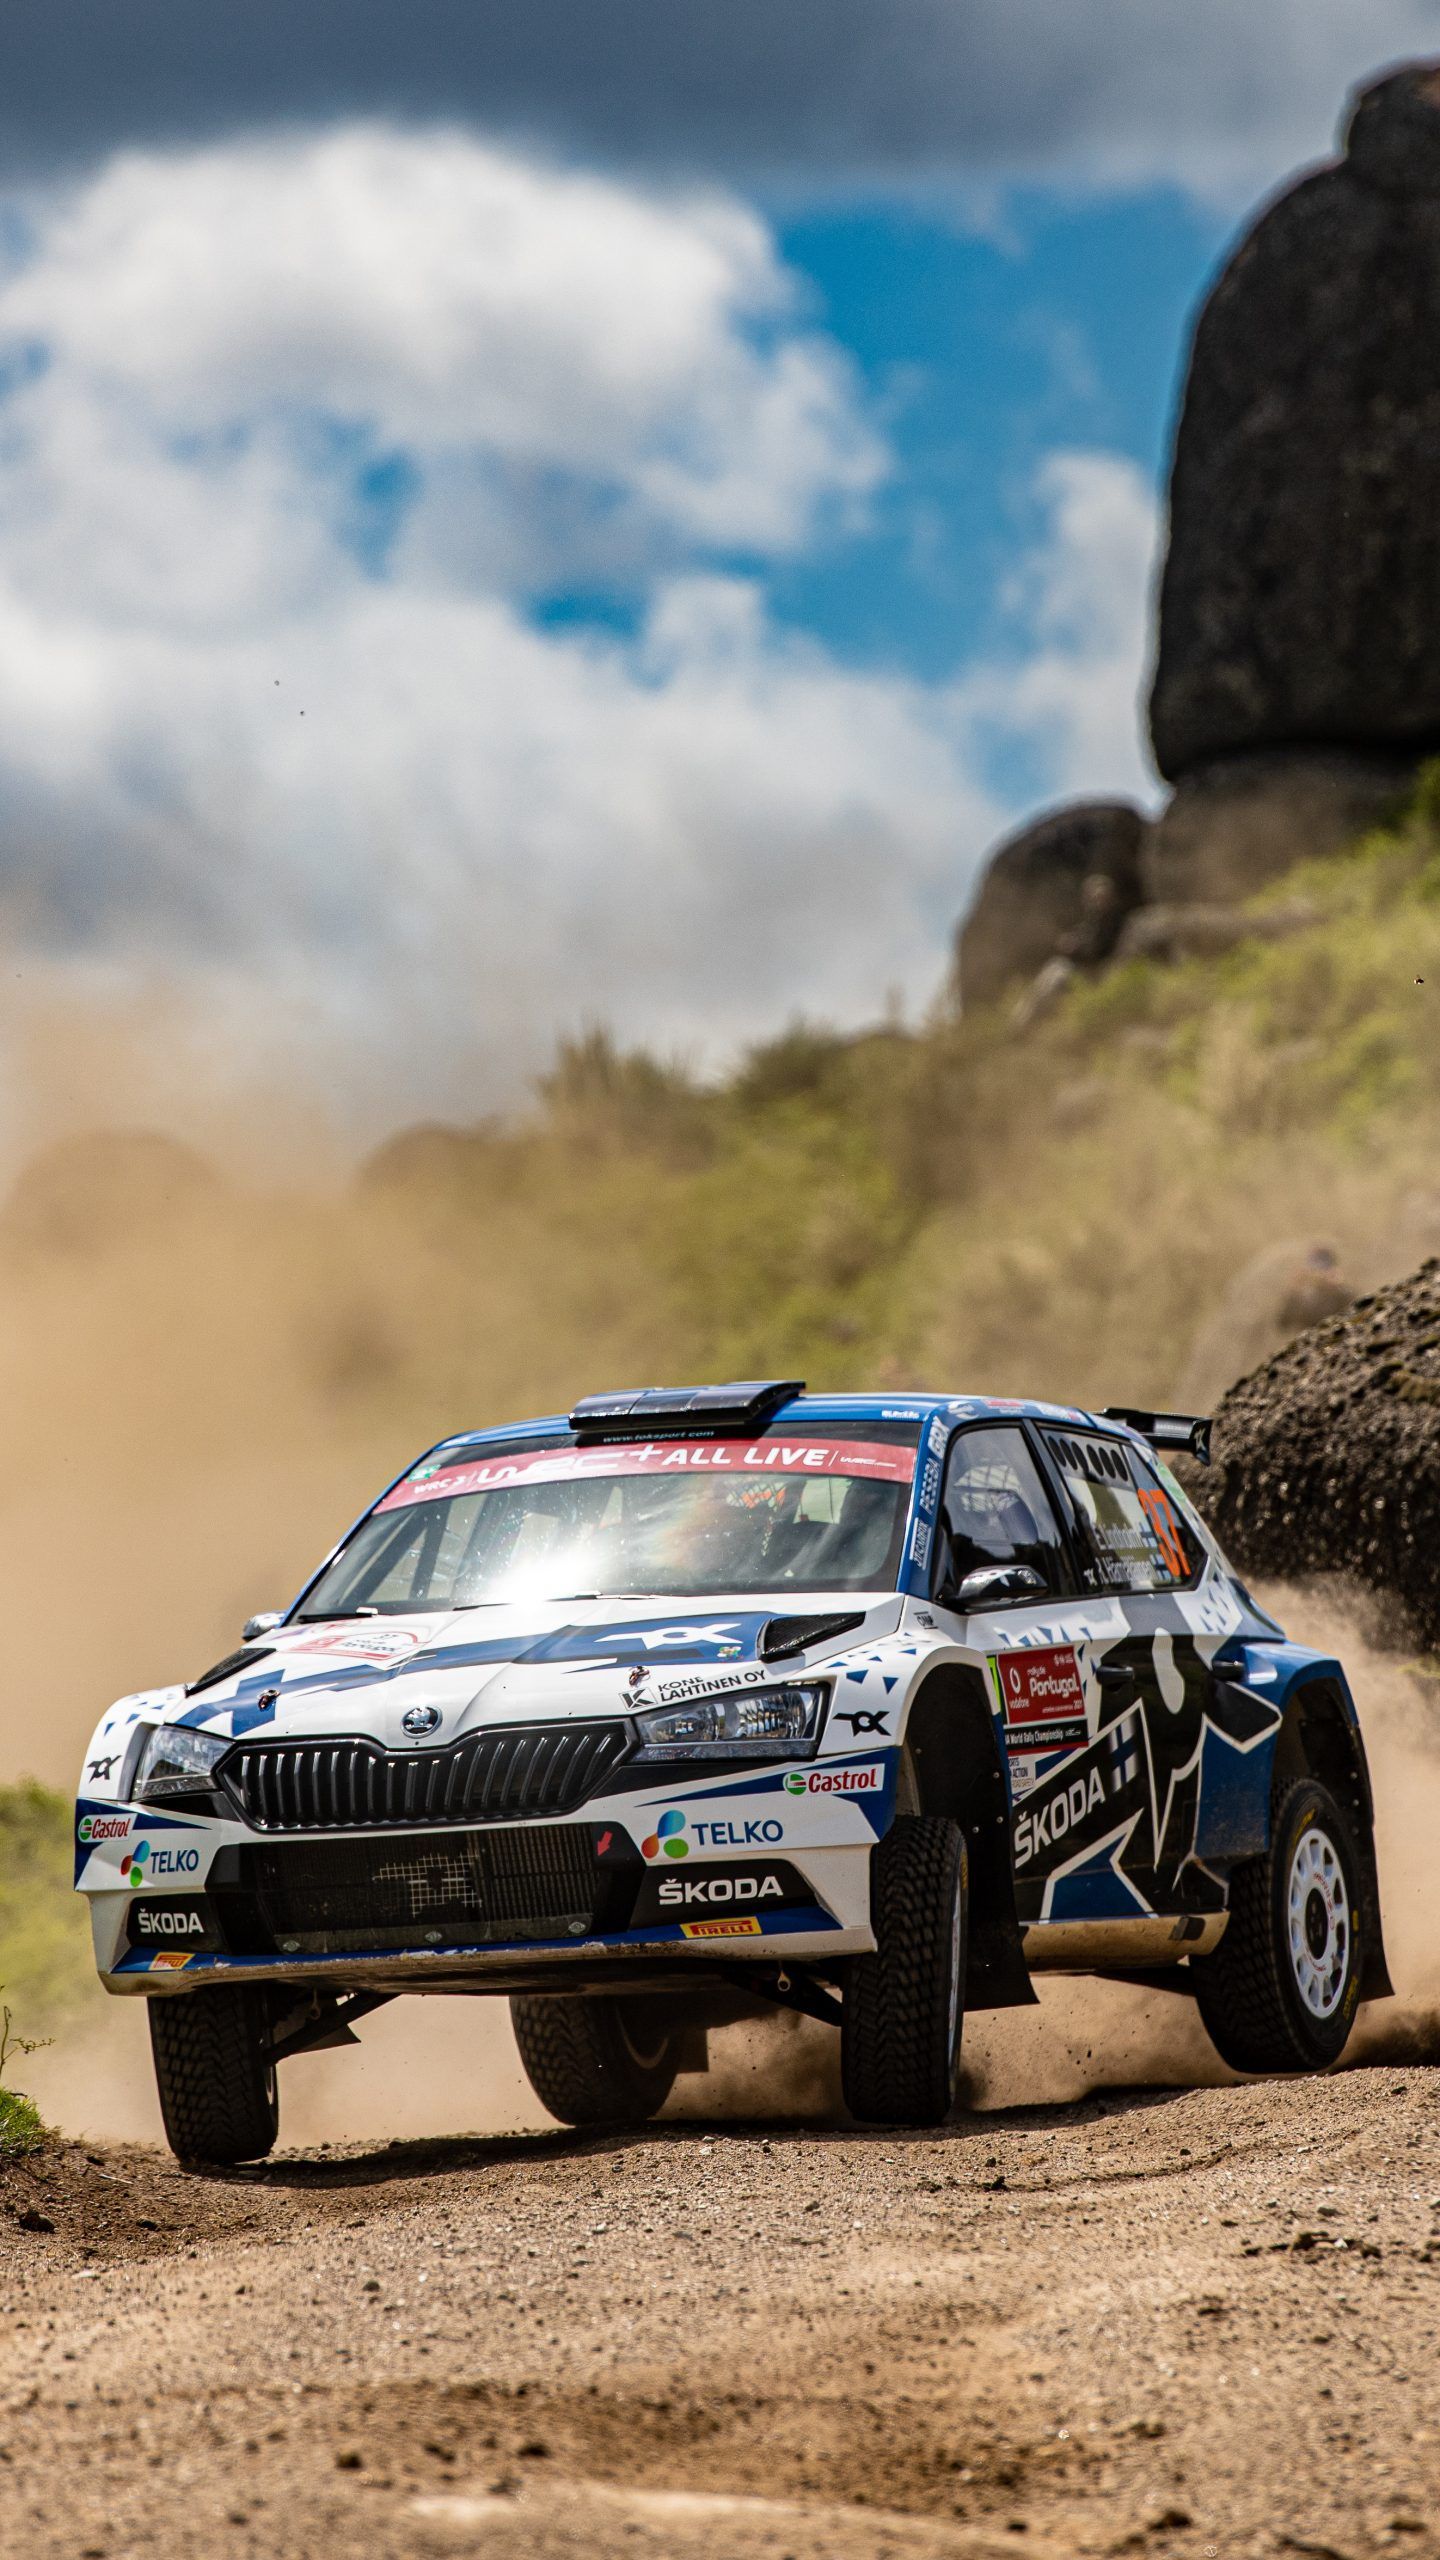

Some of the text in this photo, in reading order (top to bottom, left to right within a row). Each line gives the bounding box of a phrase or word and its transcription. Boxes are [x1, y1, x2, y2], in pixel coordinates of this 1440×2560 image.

[661, 1447, 732, 1466] ALL
[743, 1446, 830, 1467] LIVE
[660, 1669, 766, 1702] LAHTINEN OY
[1029, 1673, 1080, 1698] Portugal
[808, 1768, 877, 1794] Castrol
[92, 1818, 131, 1839] Castrol
[1014, 1766, 1106, 1869] ŠKODA
[690, 1819, 784, 1846] TELKO
[151, 1849, 199, 1874] TELKO
[658, 1875, 784, 1906] ŠKODA
[138, 1907, 204, 1934] ŠKODA
[690, 1919, 754, 1937] PIRELLI
